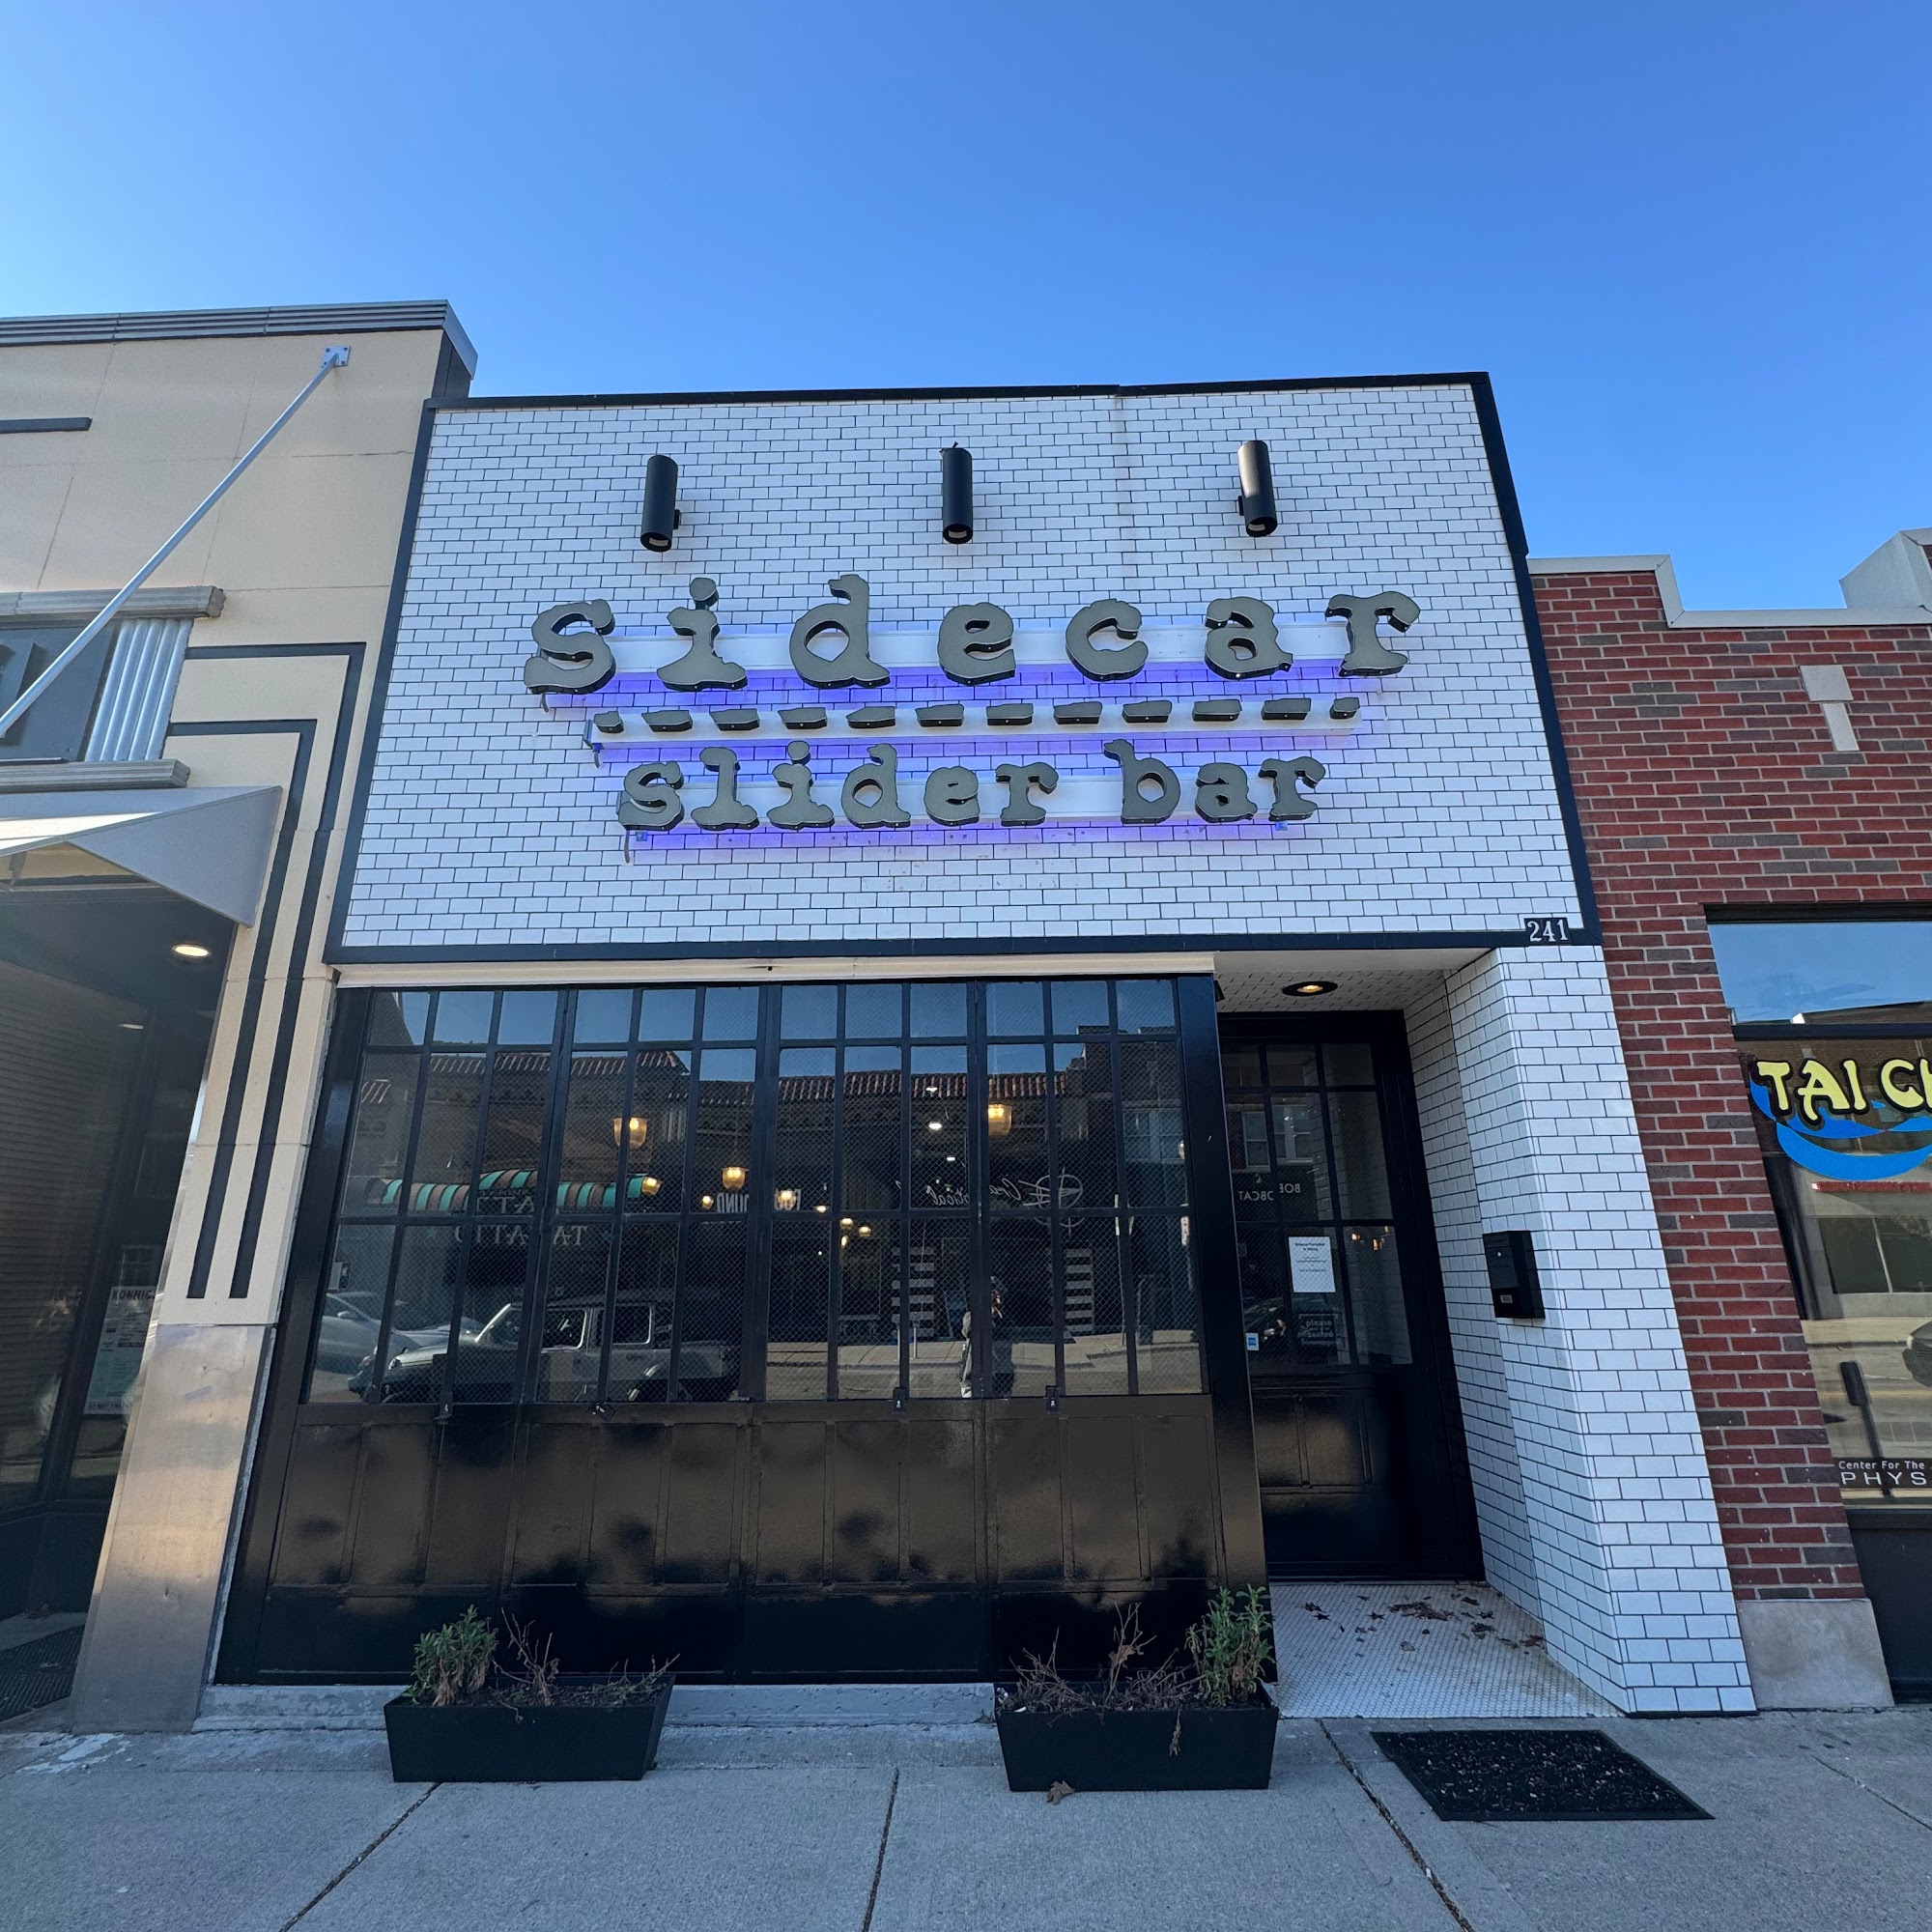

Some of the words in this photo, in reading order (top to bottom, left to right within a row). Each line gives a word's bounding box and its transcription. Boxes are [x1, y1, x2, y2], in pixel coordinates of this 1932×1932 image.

[524, 574, 1420, 694] sidecar
[616, 740, 1058, 831] slider
[1104, 739, 1327, 825] bar
[1526, 919, 1569, 943] 241
[1755, 1058, 1868, 1122] TAI
[1838, 1460, 1877, 1469] Center
[1881, 1460, 1900, 1469] For
[1904, 1460, 1925, 1469] The
[1840, 1471, 1927, 1486] PHYS
